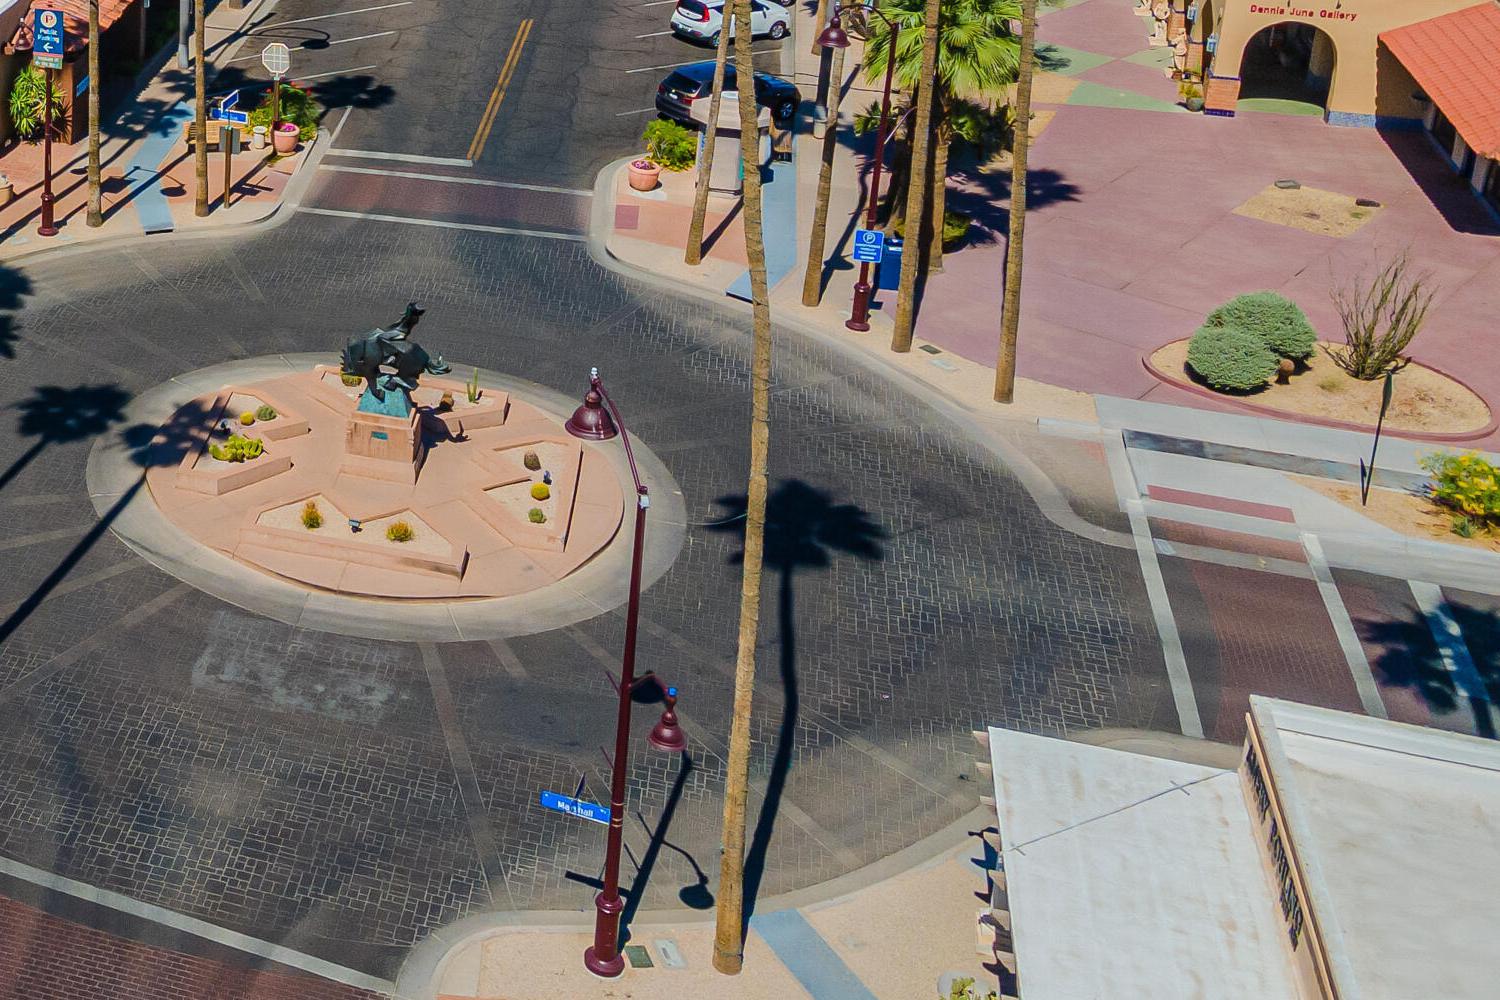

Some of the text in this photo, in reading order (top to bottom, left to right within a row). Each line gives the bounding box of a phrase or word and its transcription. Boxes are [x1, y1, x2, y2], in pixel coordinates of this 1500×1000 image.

[1290, 8, 1314, 17] June
[1320, 10, 1357, 21] Gallery
[557, 800, 594, 817] Mahall
